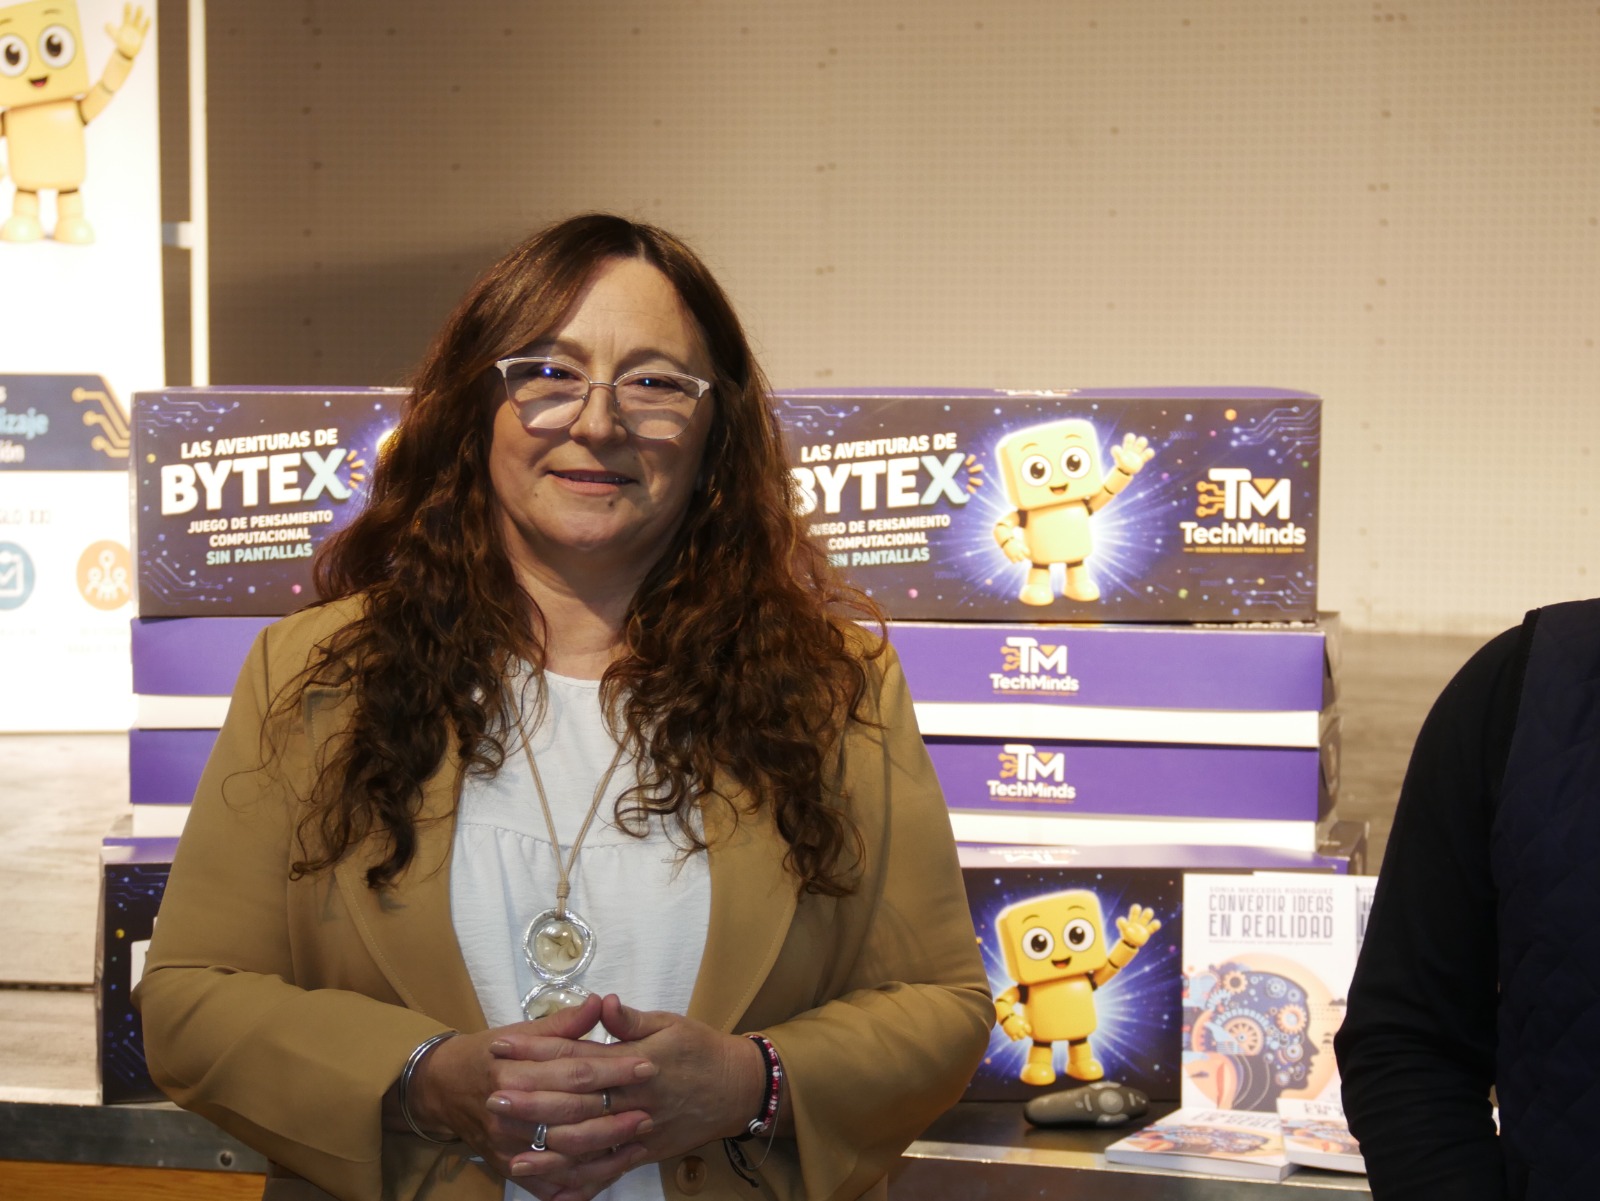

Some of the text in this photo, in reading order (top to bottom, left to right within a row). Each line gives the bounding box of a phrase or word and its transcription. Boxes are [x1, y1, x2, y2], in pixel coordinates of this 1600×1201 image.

[181, 428, 338, 459] LAS AVENTURAS DE
[801, 432, 957, 463] LAS AVENTURAS DE
[160, 448, 353, 516] BYTEX
[1208, 468, 1291, 520] TM
[187, 510, 334, 534] JUEGO DE PENSAMIENTO
[848, 520, 866, 534] DE
[867, 514, 951, 532] PENSAMIENTO
[1179, 522, 1307, 545] TechMinds
[209, 527, 312, 548] COMPUTACIONAL
[828, 531, 929, 551] COMPUTACIONAL
[206, 543, 313, 566] SIN PANTALLAS
[852, 547, 930, 567] PANTALLAS
[1006, 636, 1068, 675] TM
[989, 673, 1079, 691] TechMinds
[1003, 744, 1065, 782] TM
[986, 780, 1076, 799] TechMinds
[1208, 894, 1334, 913] CONVERTIR IDEAS
[1208, 913, 1231, 937] EN
[1241, 914, 1334, 939] REALIDAD
